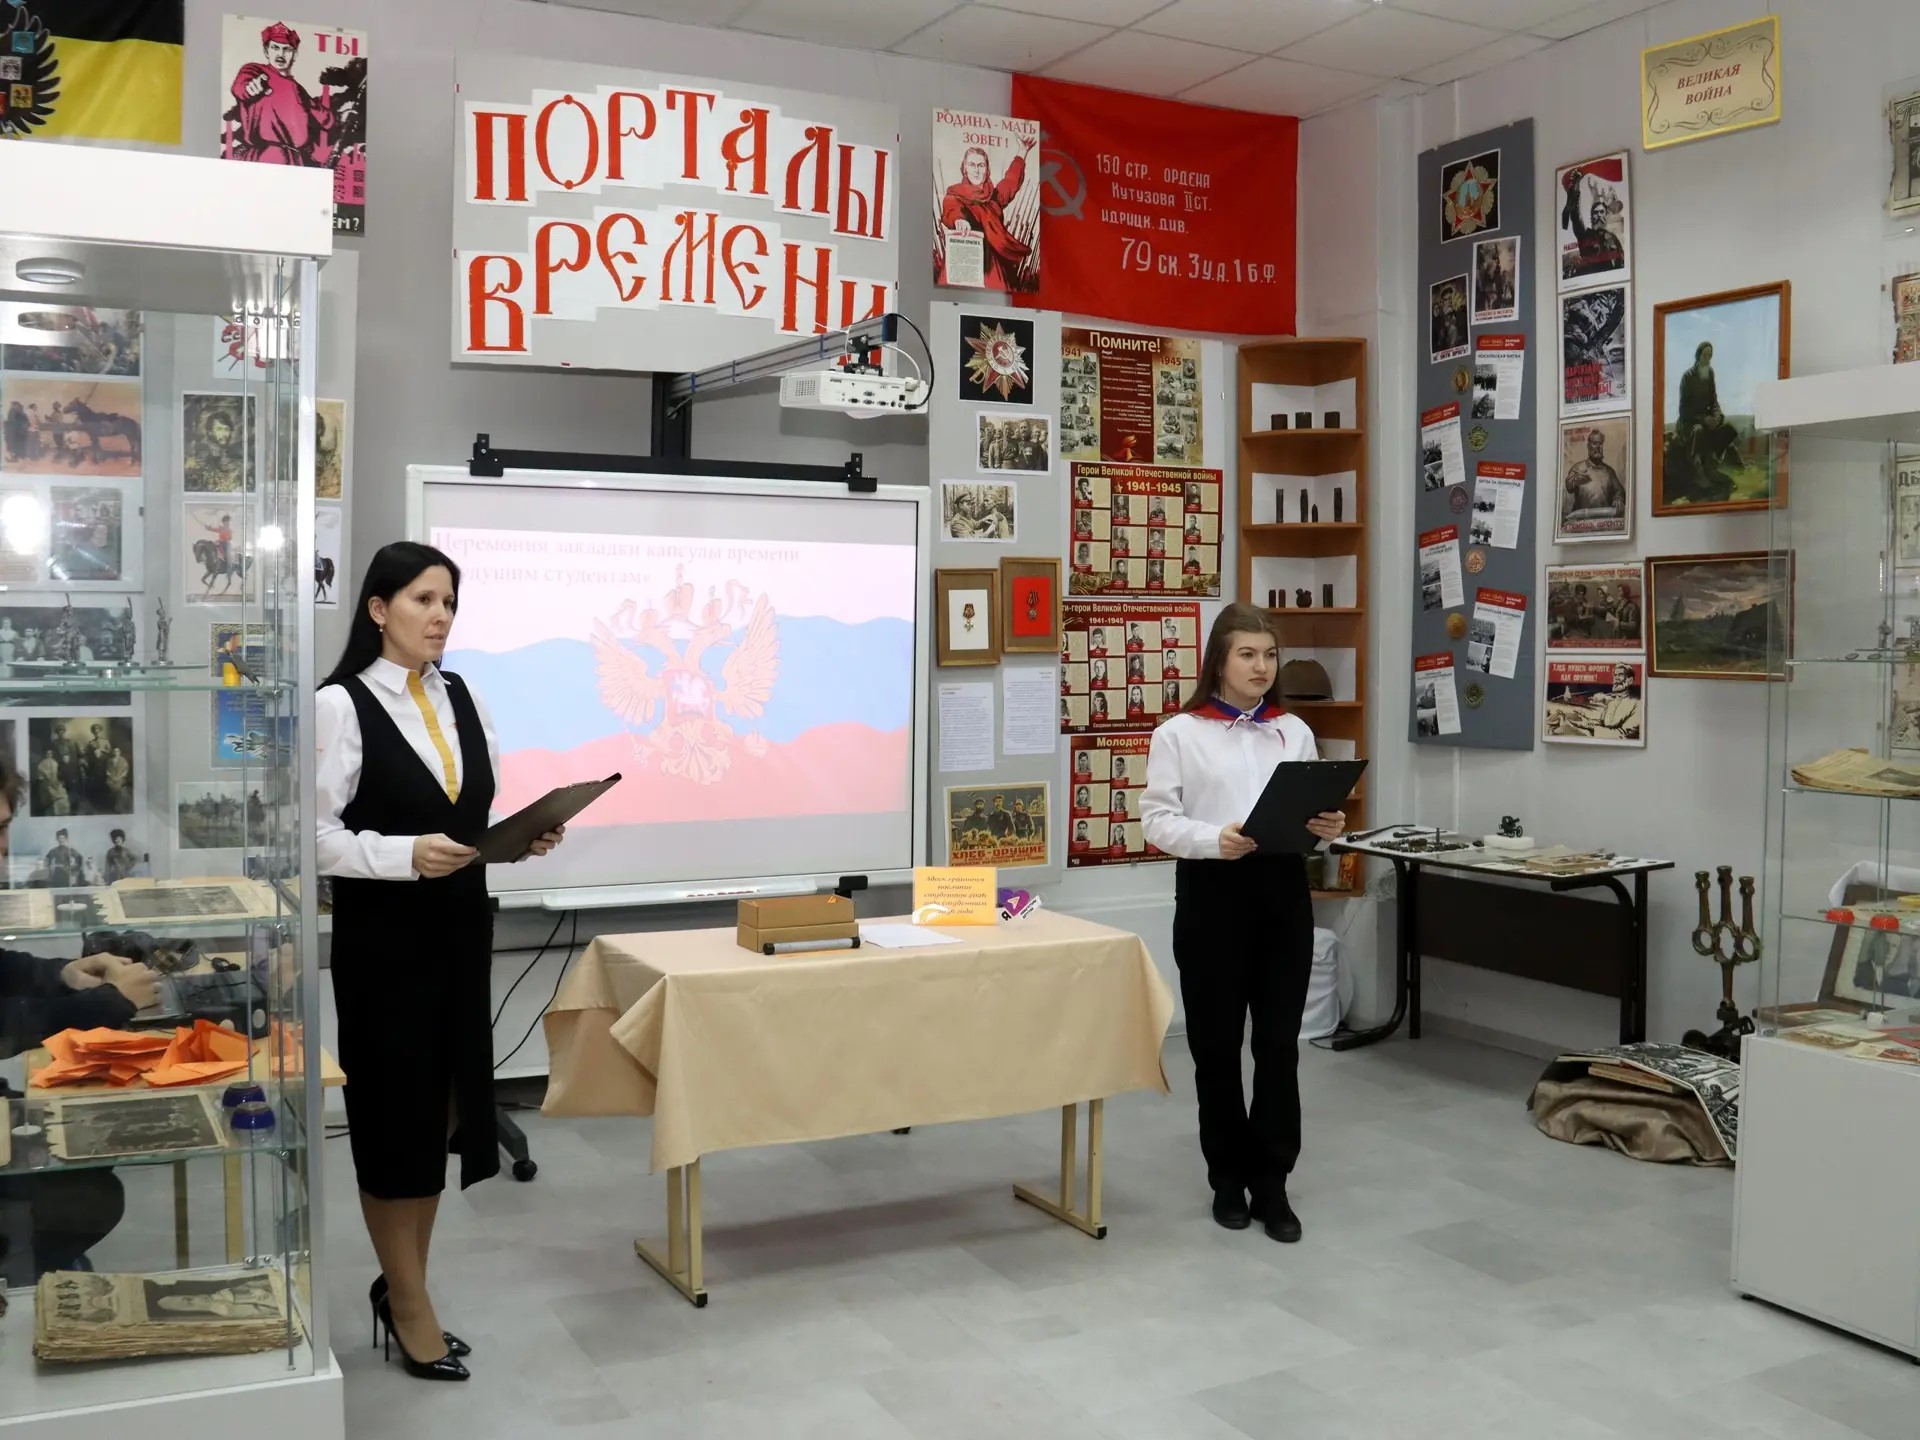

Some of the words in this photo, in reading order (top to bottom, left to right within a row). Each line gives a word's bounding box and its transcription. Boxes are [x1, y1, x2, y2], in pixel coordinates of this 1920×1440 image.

[315, 33, 358, 56] ТЫ
[1676, 63, 1742, 90] ВЕЛИКАЯ
[1685, 85, 1733, 105] ВОЙНА
[936, 112, 992, 129] РОДИНА
[1002, 120, 1036, 135] МАТЬ
[472, 90, 888, 239] ПОРТАЛЫ
[1096, 153, 1120, 176] 150
[1163, 166, 1211, 189] ОРДЕНА
[1121, 237, 1152, 272] 79
[1158, 253, 1182, 277] СК.
[467, 211, 887, 367] ВРЕМЕНИ
[1090, 332, 1161, 353] Помните!
[1160, 356, 1182, 366] 1945
[1077, 464, 1100, 477] Герои
[1101, 466, 1133, 477] Великой
[1136, 467, 1192, 480] Отечественной
[1193, 471, 1217, 481] войны
[434, 533, 549, 558] Церемония
[554, 540, 641, 560] закладки
[646, 543, 722, 567] капсулы
[727, 547, 800, 566] времени
[1062, 604, 1091, 614] ти-герои
[1093, 604, 1122, 613] Великой
[1123, 604, 1173, 614] Отечественной
[1174, 604, 1196, 613] войны
[1097, 737, 1151, 748] Молодогв
[952, 849, 986, 860] ХЛЕБ
[992, 845, 1045, 857] ОРУЖИЕ
[1001, 910, 1012, 921] Я
